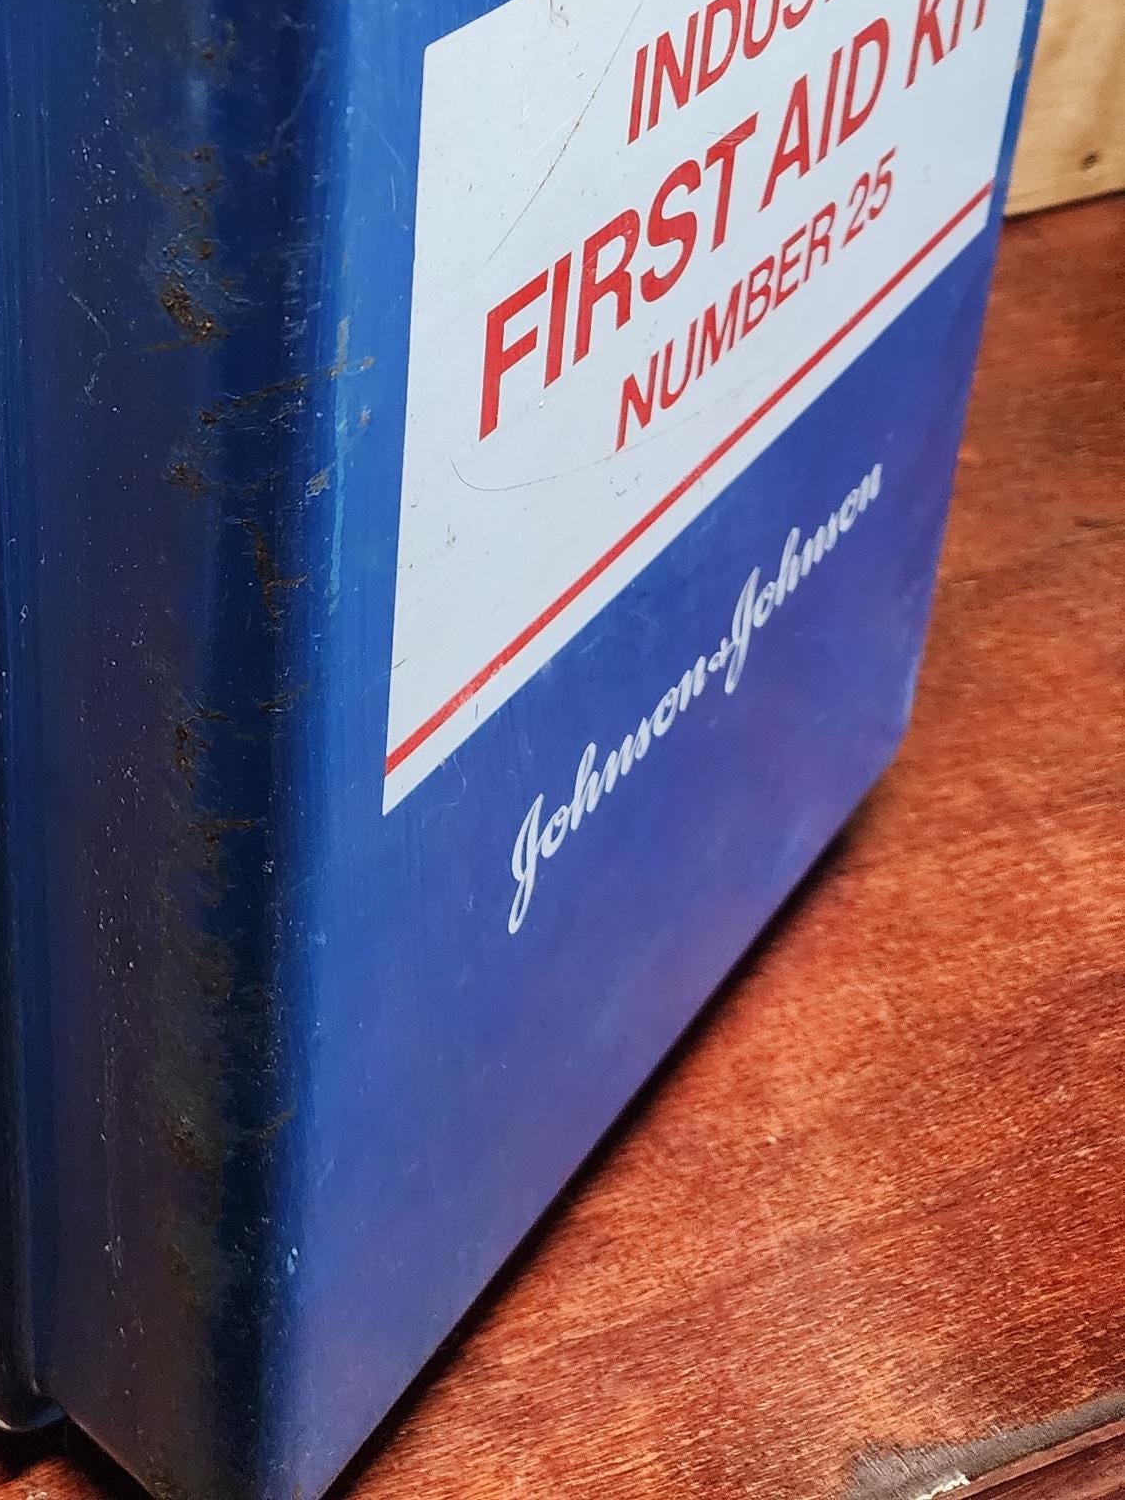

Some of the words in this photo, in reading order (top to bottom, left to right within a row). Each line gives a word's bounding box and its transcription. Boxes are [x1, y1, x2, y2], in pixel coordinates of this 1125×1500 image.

[478, 112, 759, 442] FIRST
[760, 17, 890, 211] AID
[615, 208, 834, 451] NUMBER
[842, 146, 899, 249] 25
[508, 655, 707, 934] Johnson
[724, 463, 884, 694] Johnson
